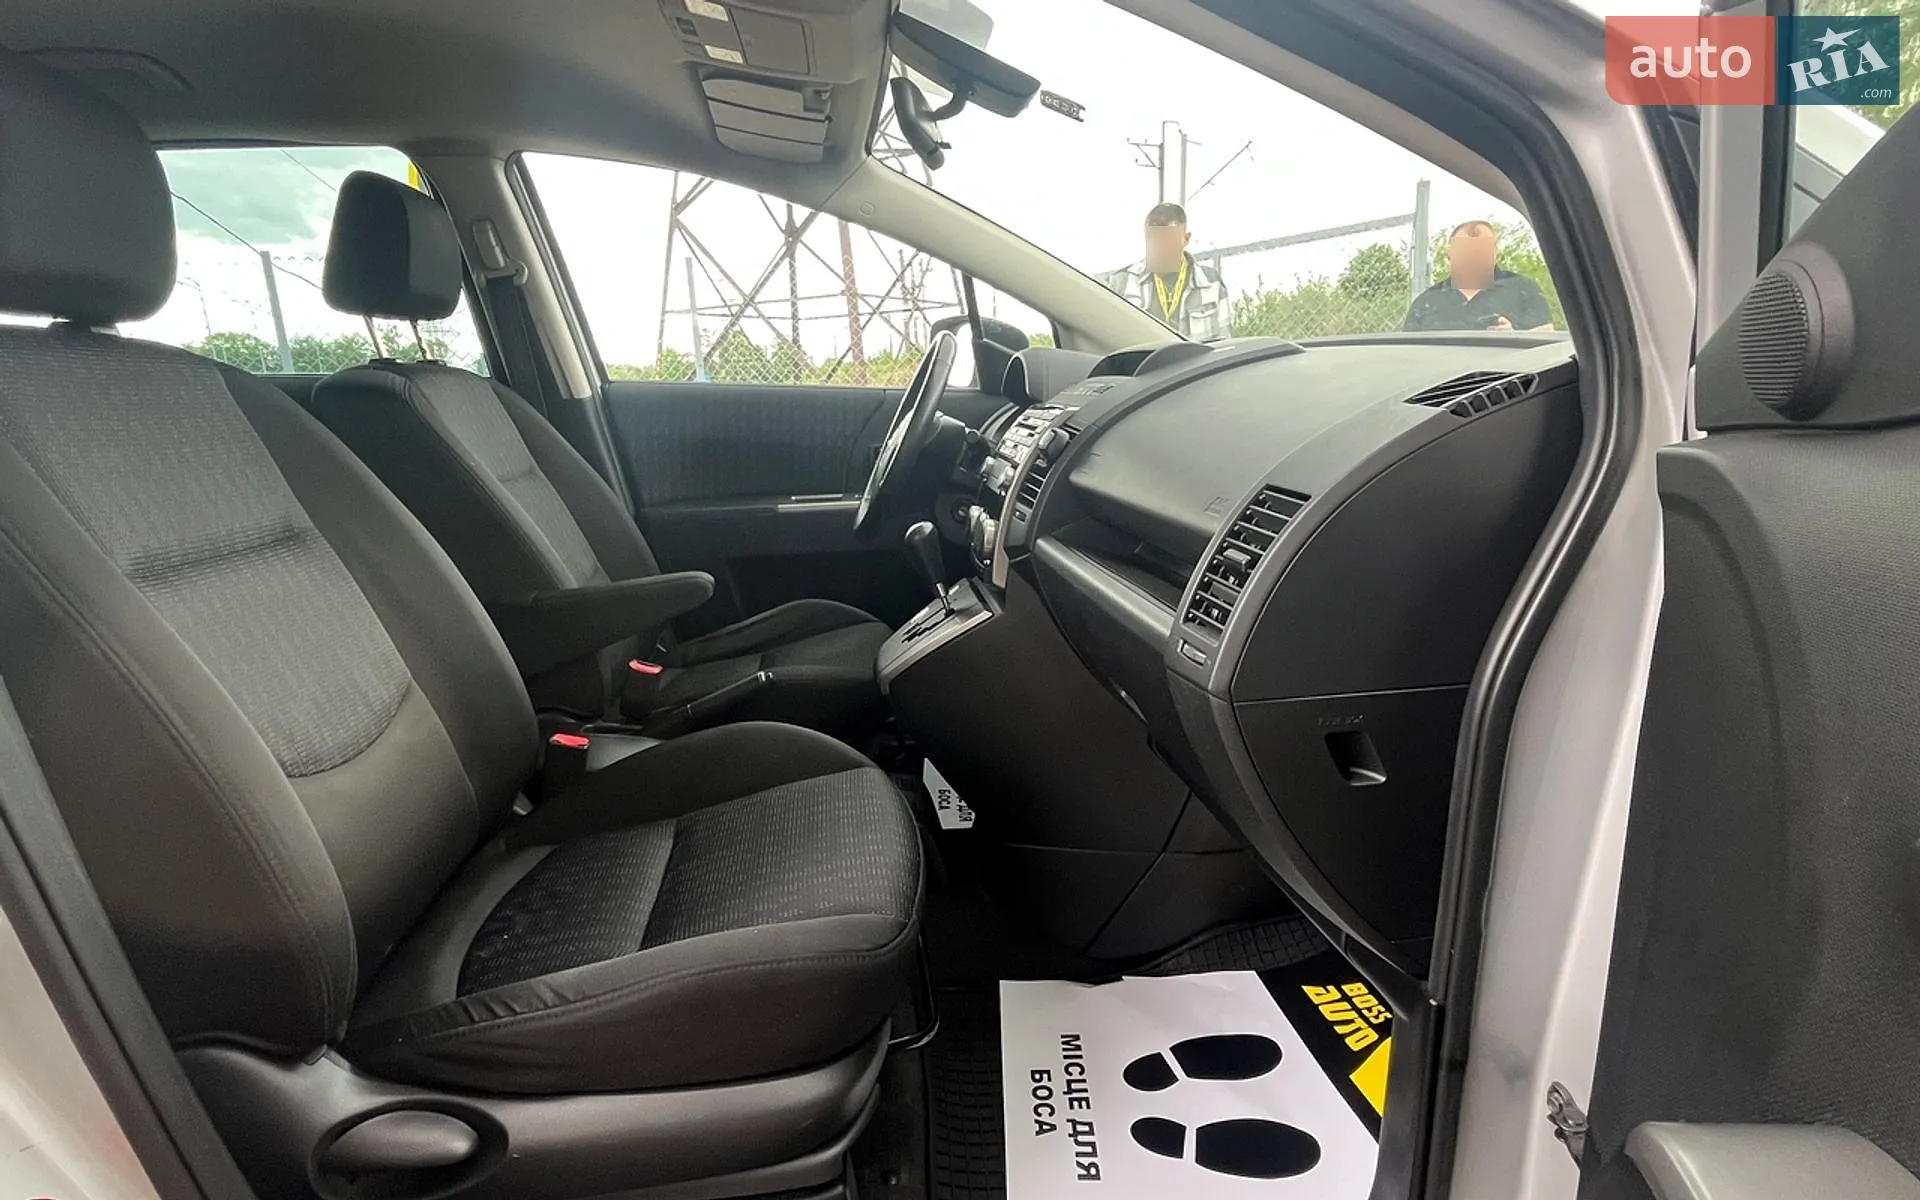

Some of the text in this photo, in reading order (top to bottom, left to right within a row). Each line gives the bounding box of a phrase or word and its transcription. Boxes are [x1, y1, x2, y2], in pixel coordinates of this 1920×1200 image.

[1301, 984, 1380, 1052] AUTO
[1341, 982, 1393, 1025] BOSS
[1030, 1069, 1058, 1137] БОСА
[1060, 1033, 1102, 1181] МІСЦЕ ДЛЯ
